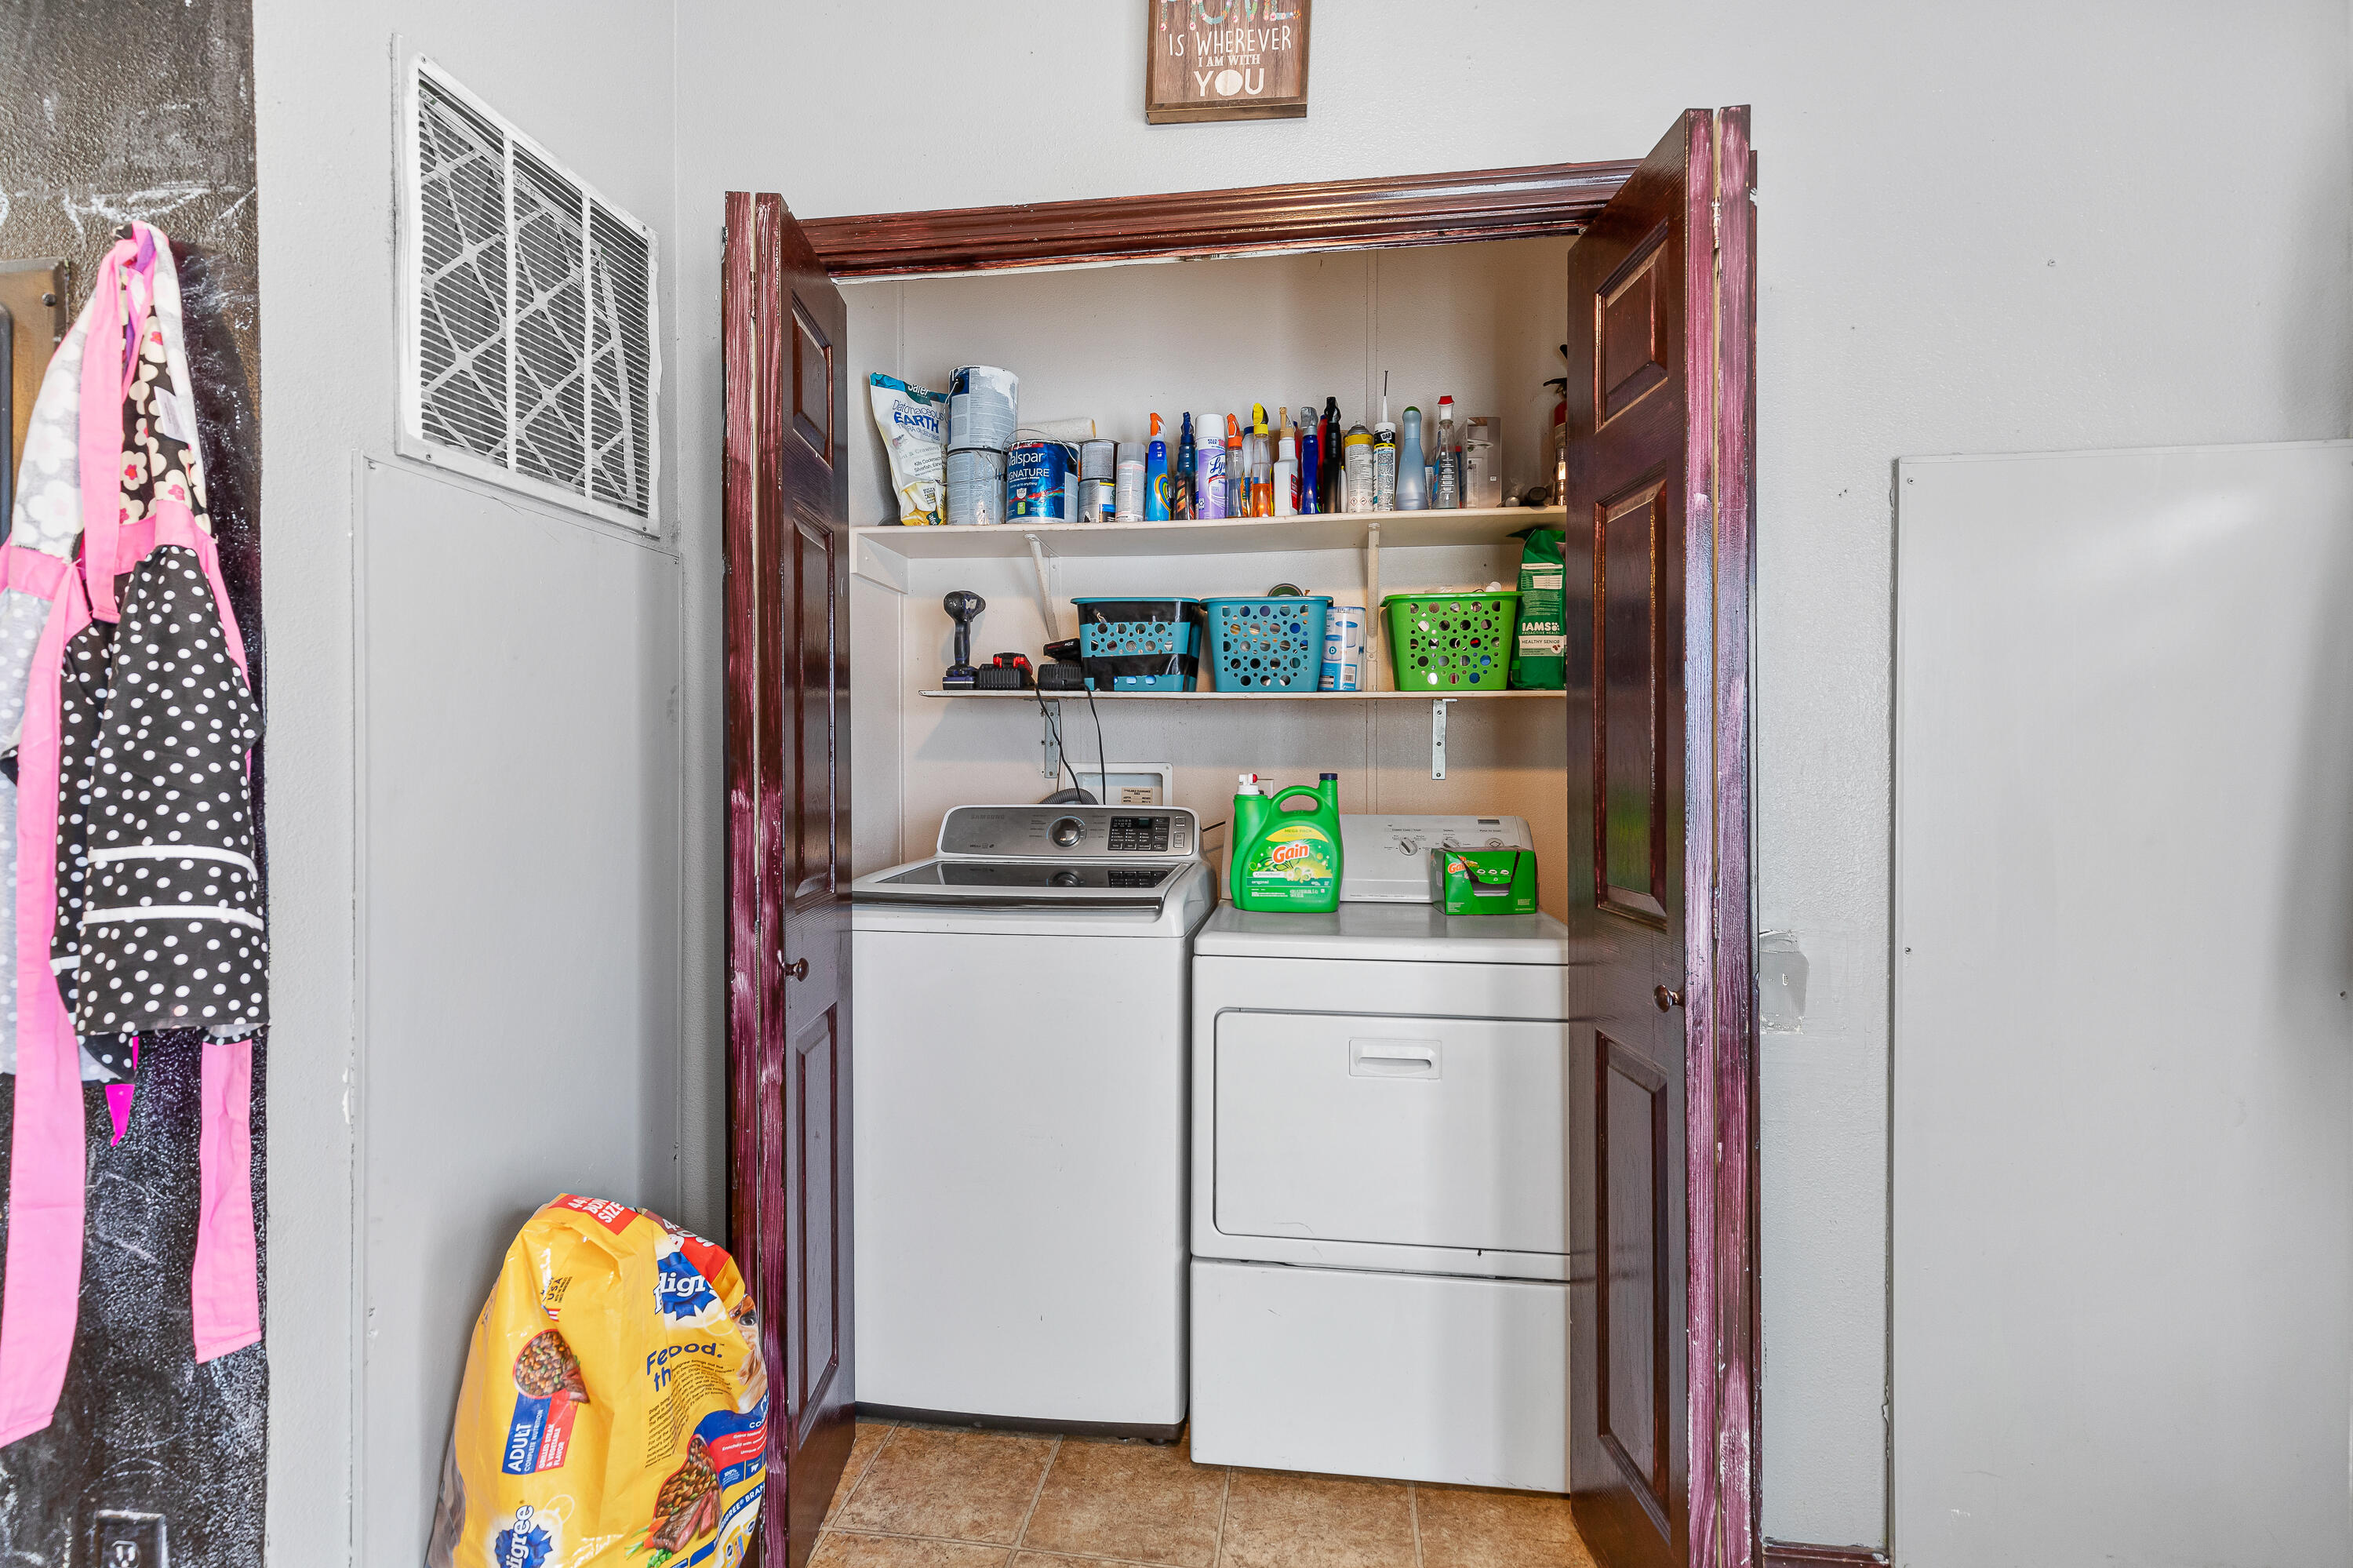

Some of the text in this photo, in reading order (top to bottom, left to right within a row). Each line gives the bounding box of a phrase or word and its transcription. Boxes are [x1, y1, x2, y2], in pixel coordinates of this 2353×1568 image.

[1169, 25, 1292, 56] IS WHEREVER
[1198, 54, 1260, 67] I AM WITH
[1194, 67, 1264, 97] YOU
[893, 411, 939, 434] EARTH
[1522, 621, 1551, 631] IAMS
[1272, 843, 1308, 864] Gain
[598, 1201, 625, 1224] SIZE
[507, 1423, 532, 1472] ADULT
[524, 1409, 544, 1472] COMPLETE NUTRITION
[538, 1423, 555, 1469] GRILLED STEAK
[548, 1428, 562, 1461] VEGETABLE
[553, 1441, 566, 1467] FLAVOR
[745, 1483, 766, 1503] BRAN
